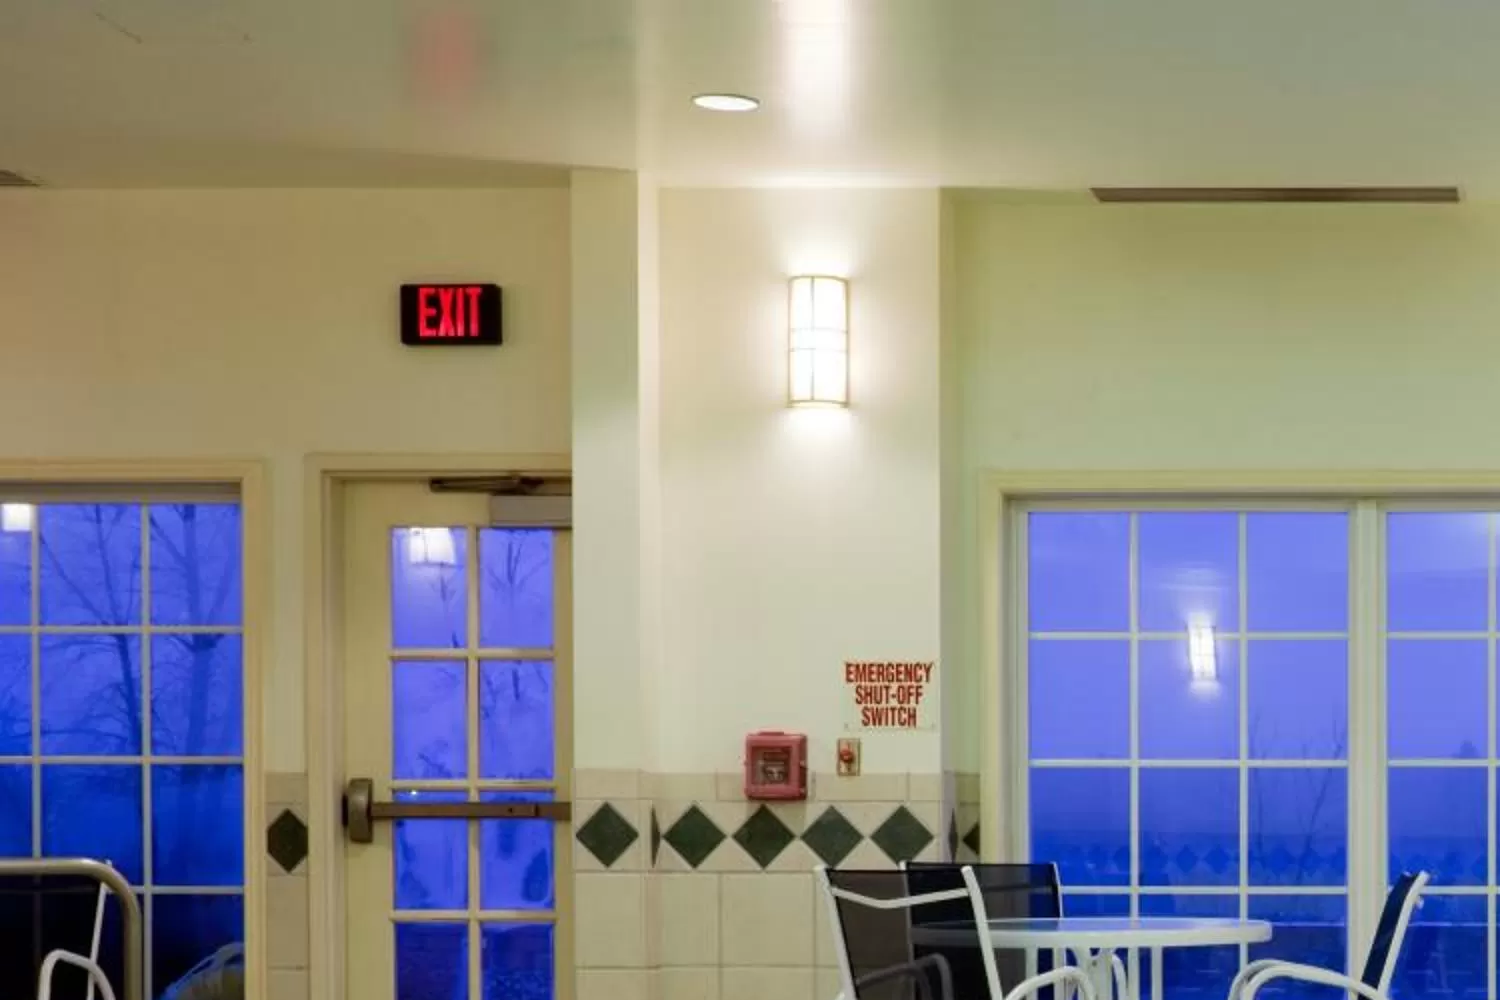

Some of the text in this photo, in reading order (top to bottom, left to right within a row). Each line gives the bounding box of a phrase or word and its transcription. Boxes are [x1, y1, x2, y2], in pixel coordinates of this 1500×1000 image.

[418, 287, 482, 337] EXIT
[845, 662, 932, 683] EMERGENCY
[855, 685, 922, 705] SHUT-OFF
[861, 706, 916, 728] SWITCH
